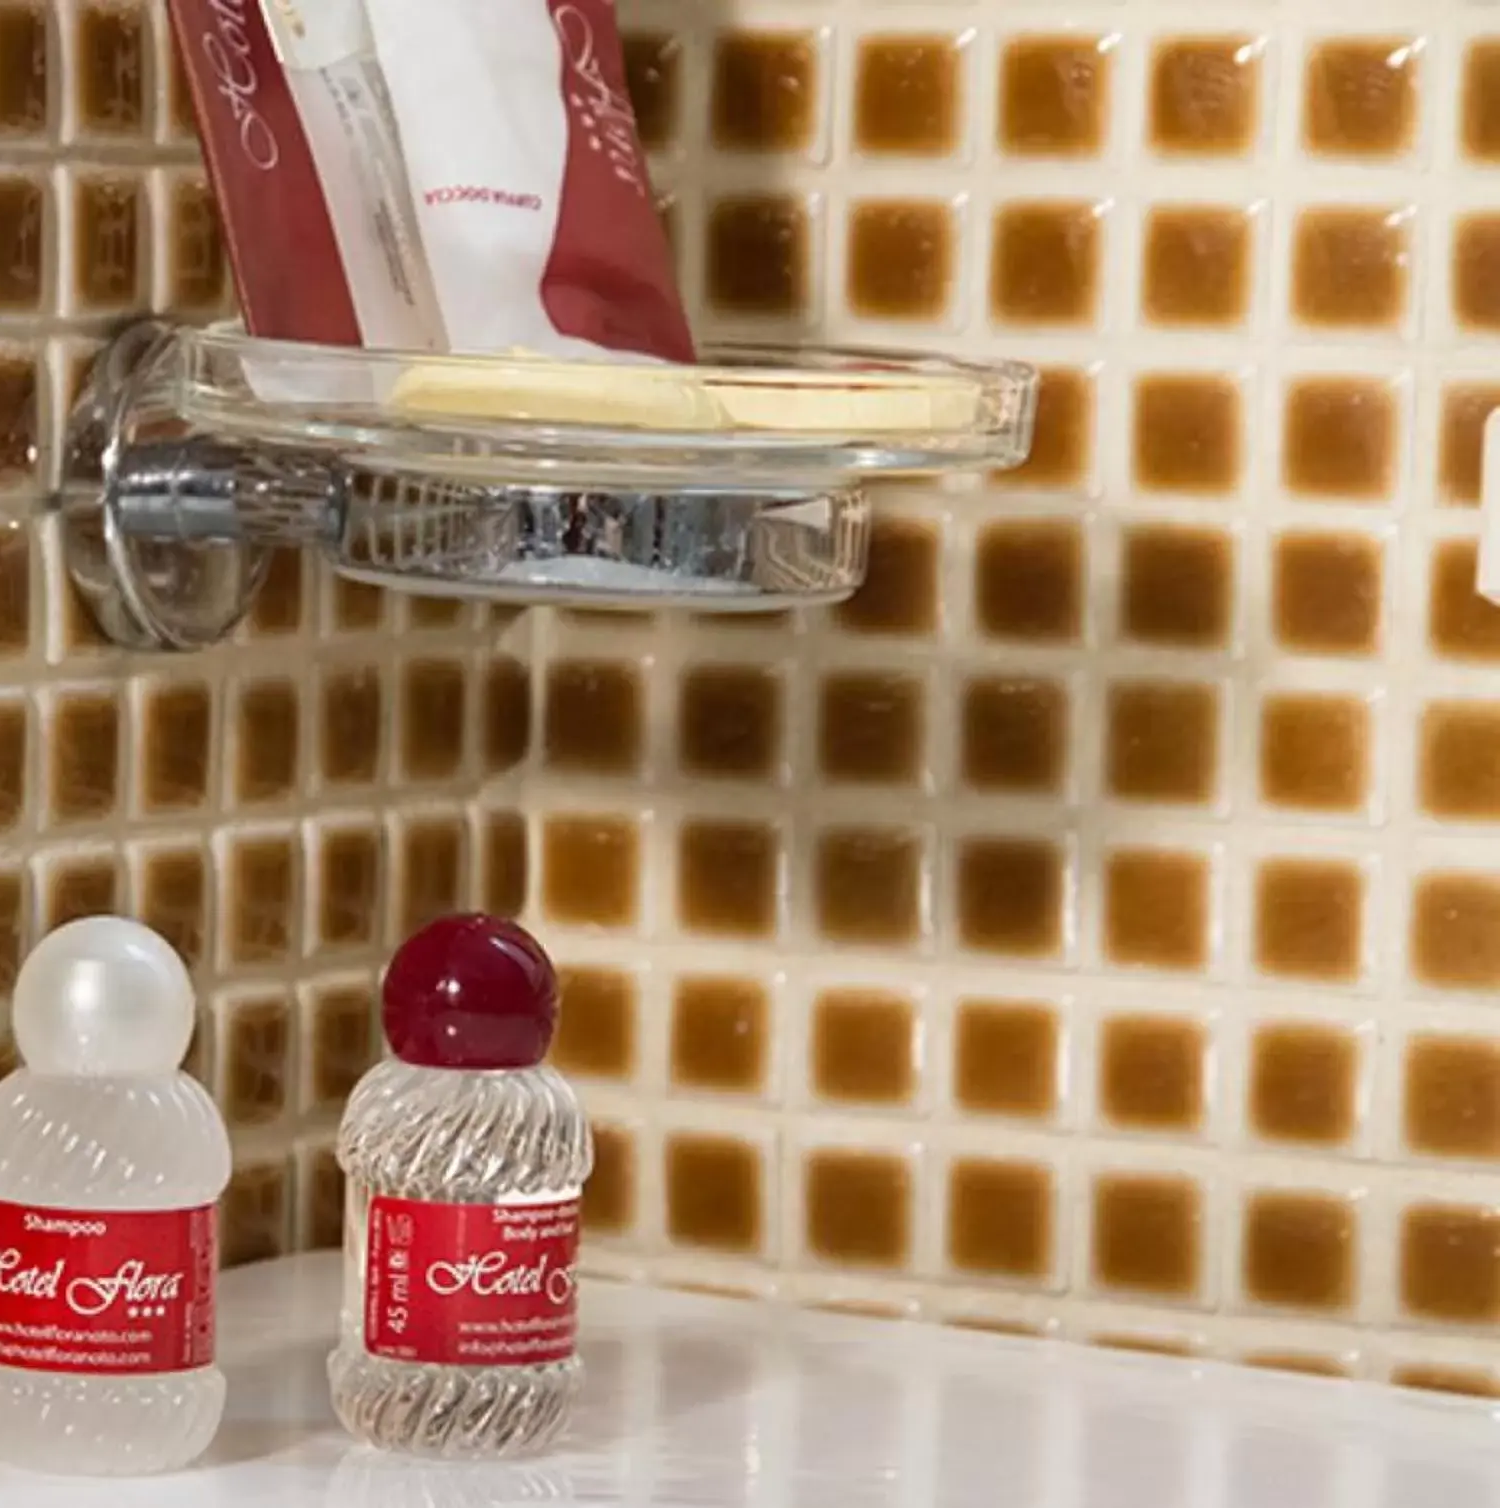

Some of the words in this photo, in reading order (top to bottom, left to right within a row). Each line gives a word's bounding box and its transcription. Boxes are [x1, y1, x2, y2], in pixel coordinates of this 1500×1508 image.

[23, 1213, 107, 1238] Shampoo
[65, 1259, 184, 1316] Flora
[389, 1273, 411, 1301] ml
[425, 1250, 548, 1296] Hotel
[386, 1305, 410, 1335] 45
